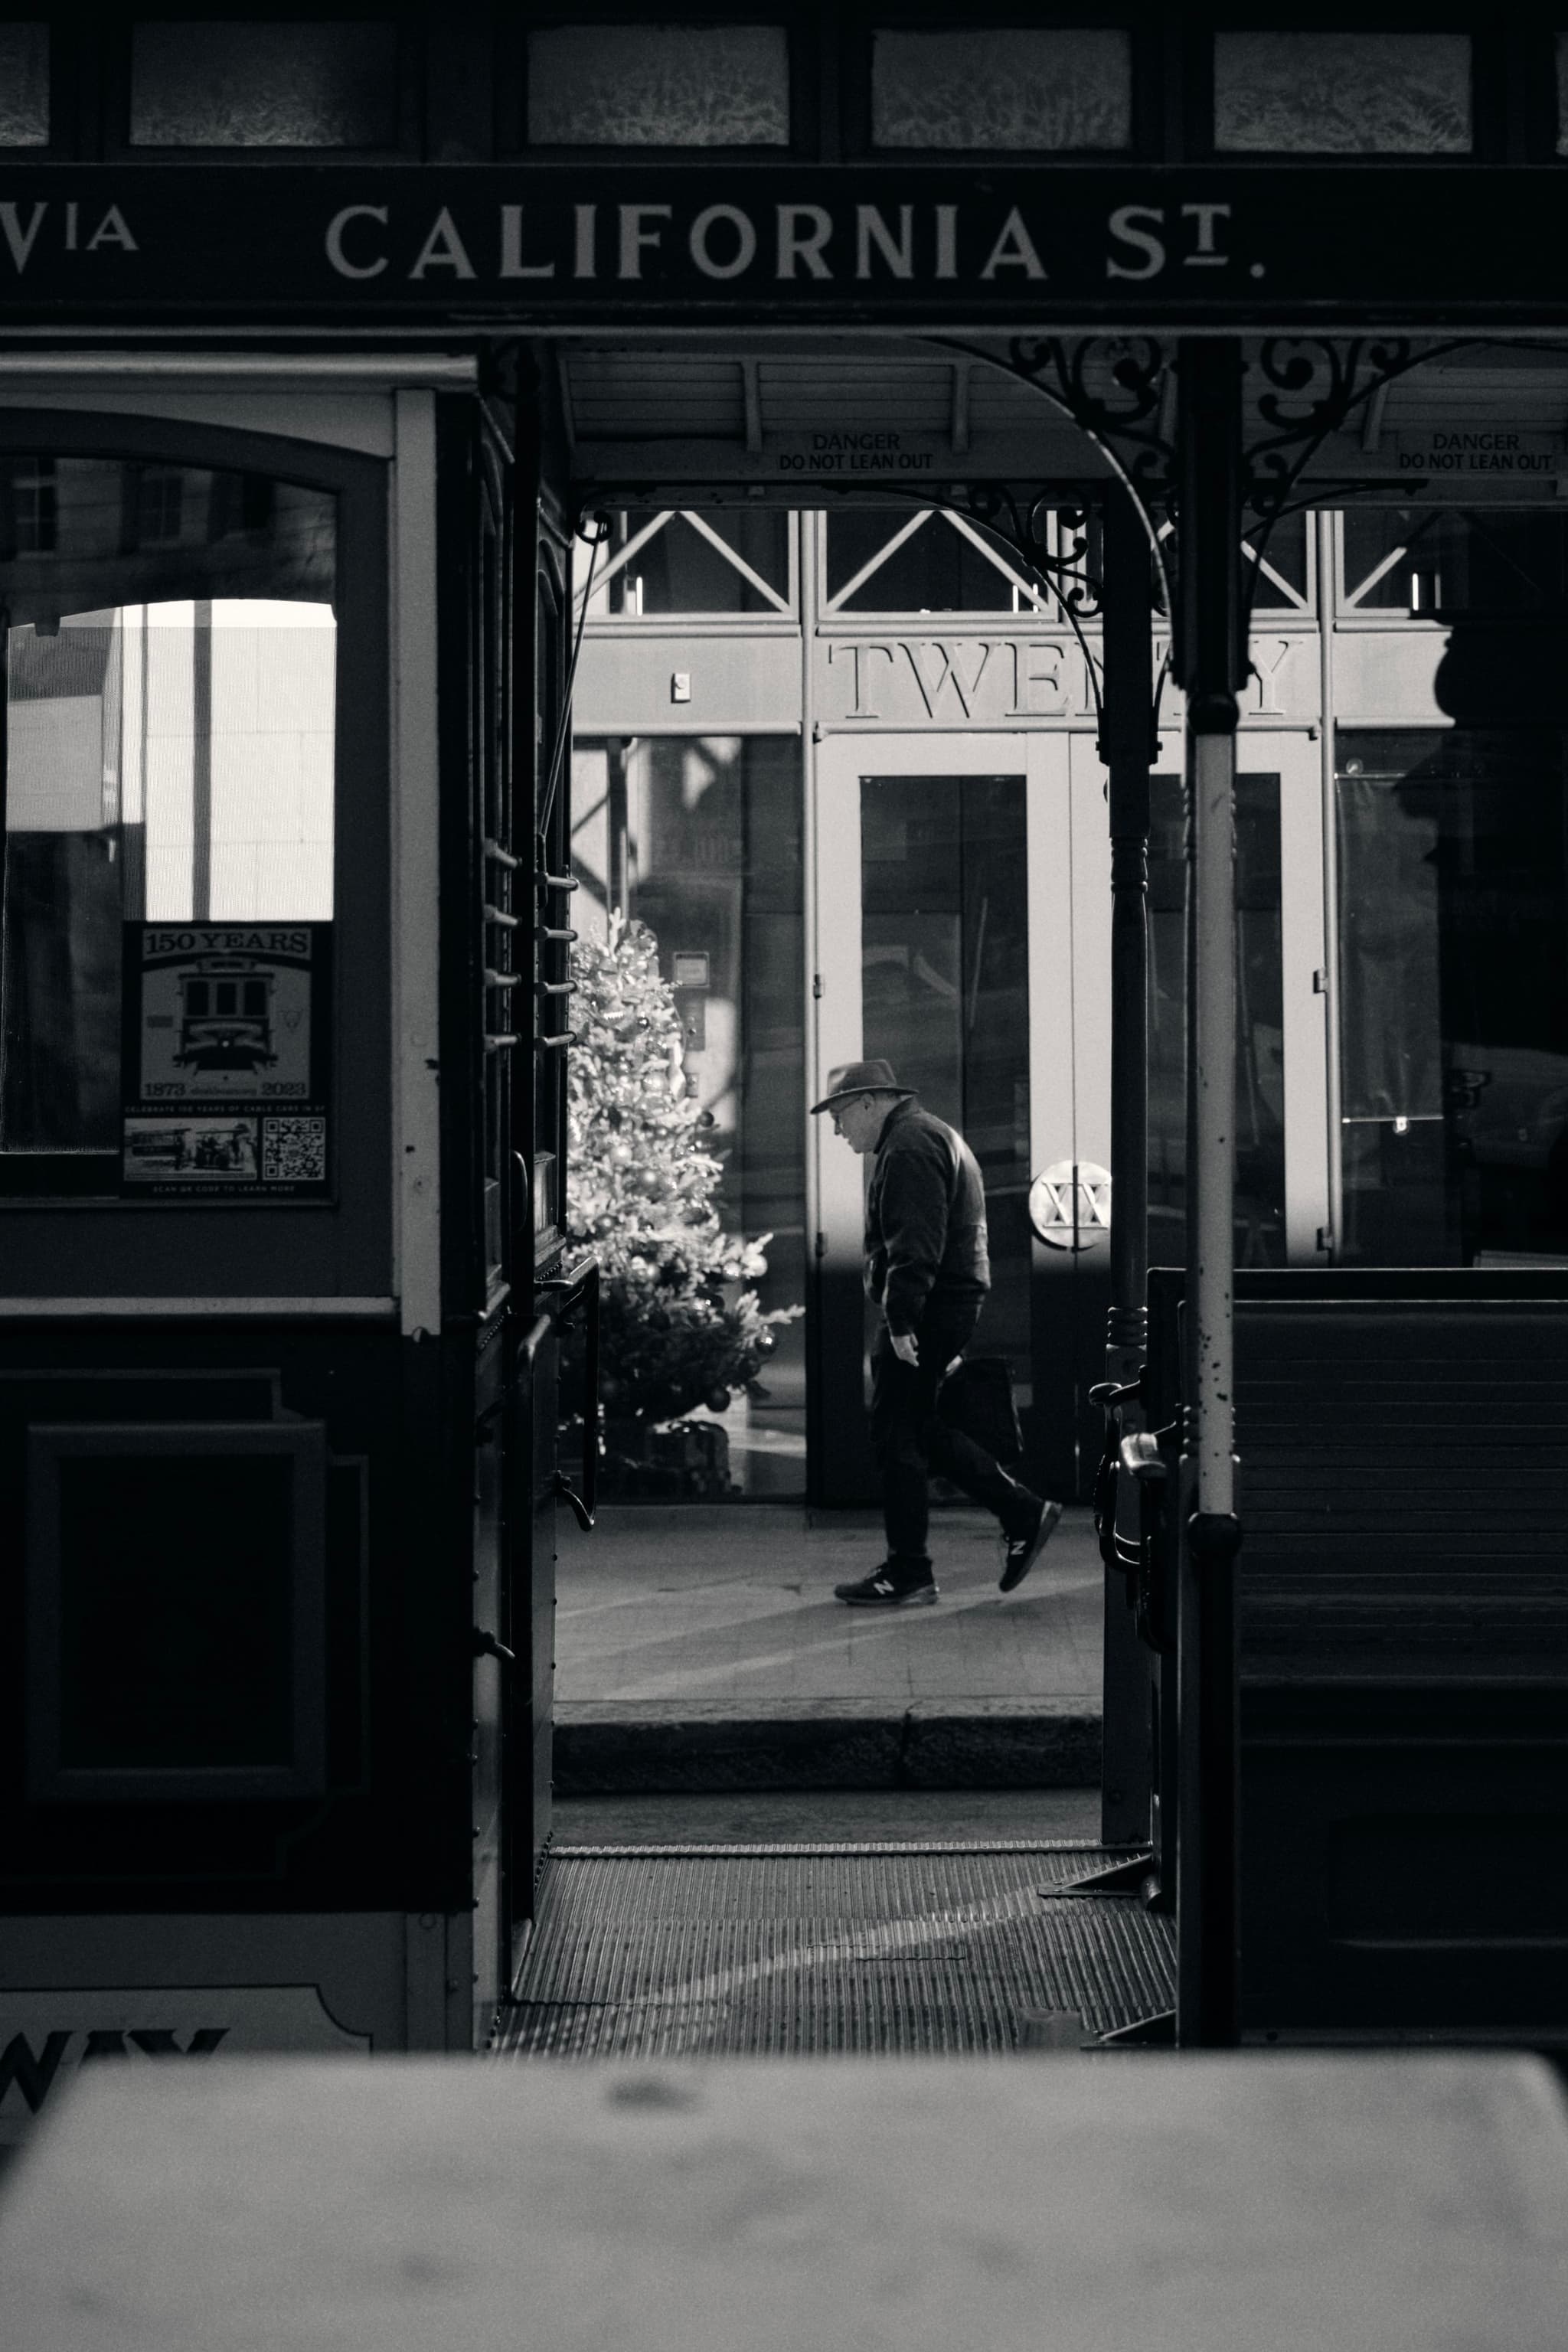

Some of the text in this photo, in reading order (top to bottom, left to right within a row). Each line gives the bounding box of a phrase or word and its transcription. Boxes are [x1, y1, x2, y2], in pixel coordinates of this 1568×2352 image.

[0, 202, 139, 275] VIA
[325, 202, 1049, 281] CALIFORNIA
[813, 433, 900, 450] DANGER
[1433, 433, 1520, 450] DANGER
[779, 453, 933, 470] DO NOT LEAN OUT
[1400, 453, 1553, 470] DO NOT LEAN OUT
[828, 641, 1305, 718] TWEY
[146, 933, 308, 954] 150 YEARS
[145, 1083, 185, 1096] 1873
[262, 1082, 306, 1096] 2023
[1041, 1181, 1109, 1230] XX
